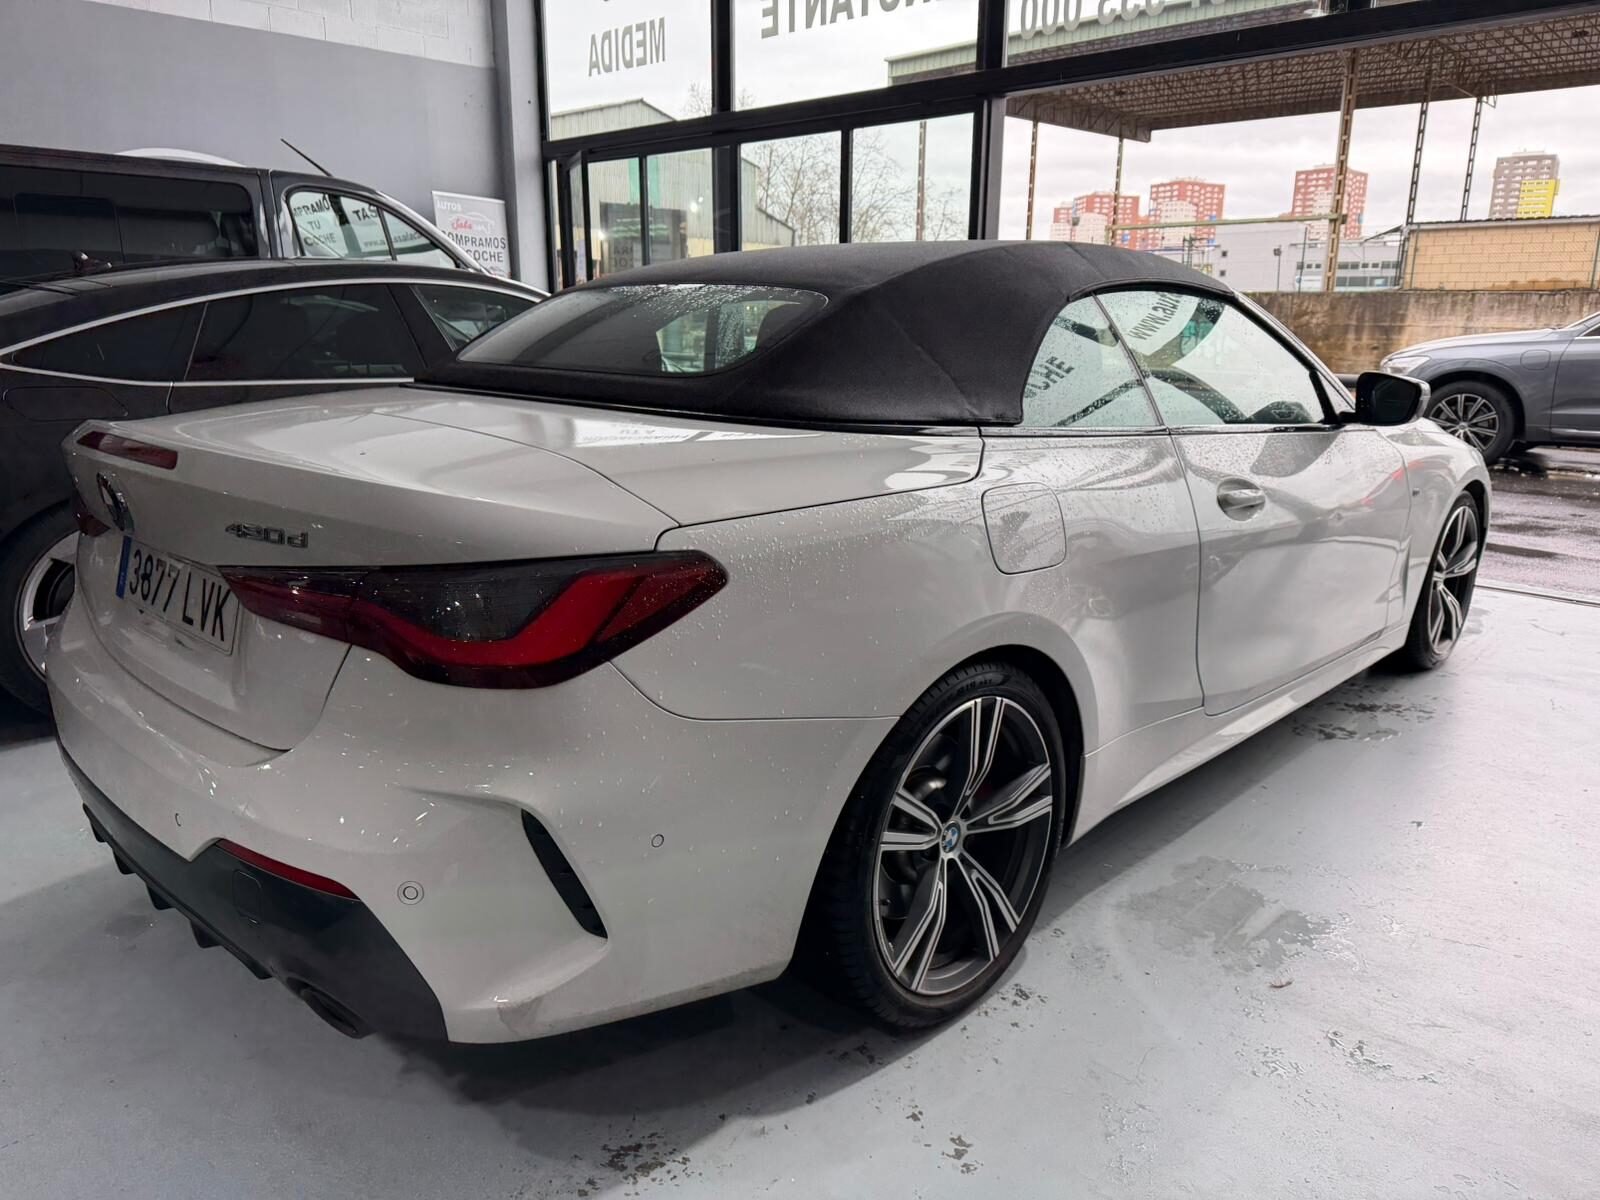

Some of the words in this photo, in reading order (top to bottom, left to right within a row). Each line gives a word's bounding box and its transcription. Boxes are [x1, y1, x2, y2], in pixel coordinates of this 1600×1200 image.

[307, 220, 321, 231] TU
[441, 230, 506, 250] OMPRAMOS
[1128, 292, 1182, 341] www.aut
[224, 522, 309, 549] 430d
[129, 549, 181, 613] 3877
[182, 570, 231, 642] LVK
